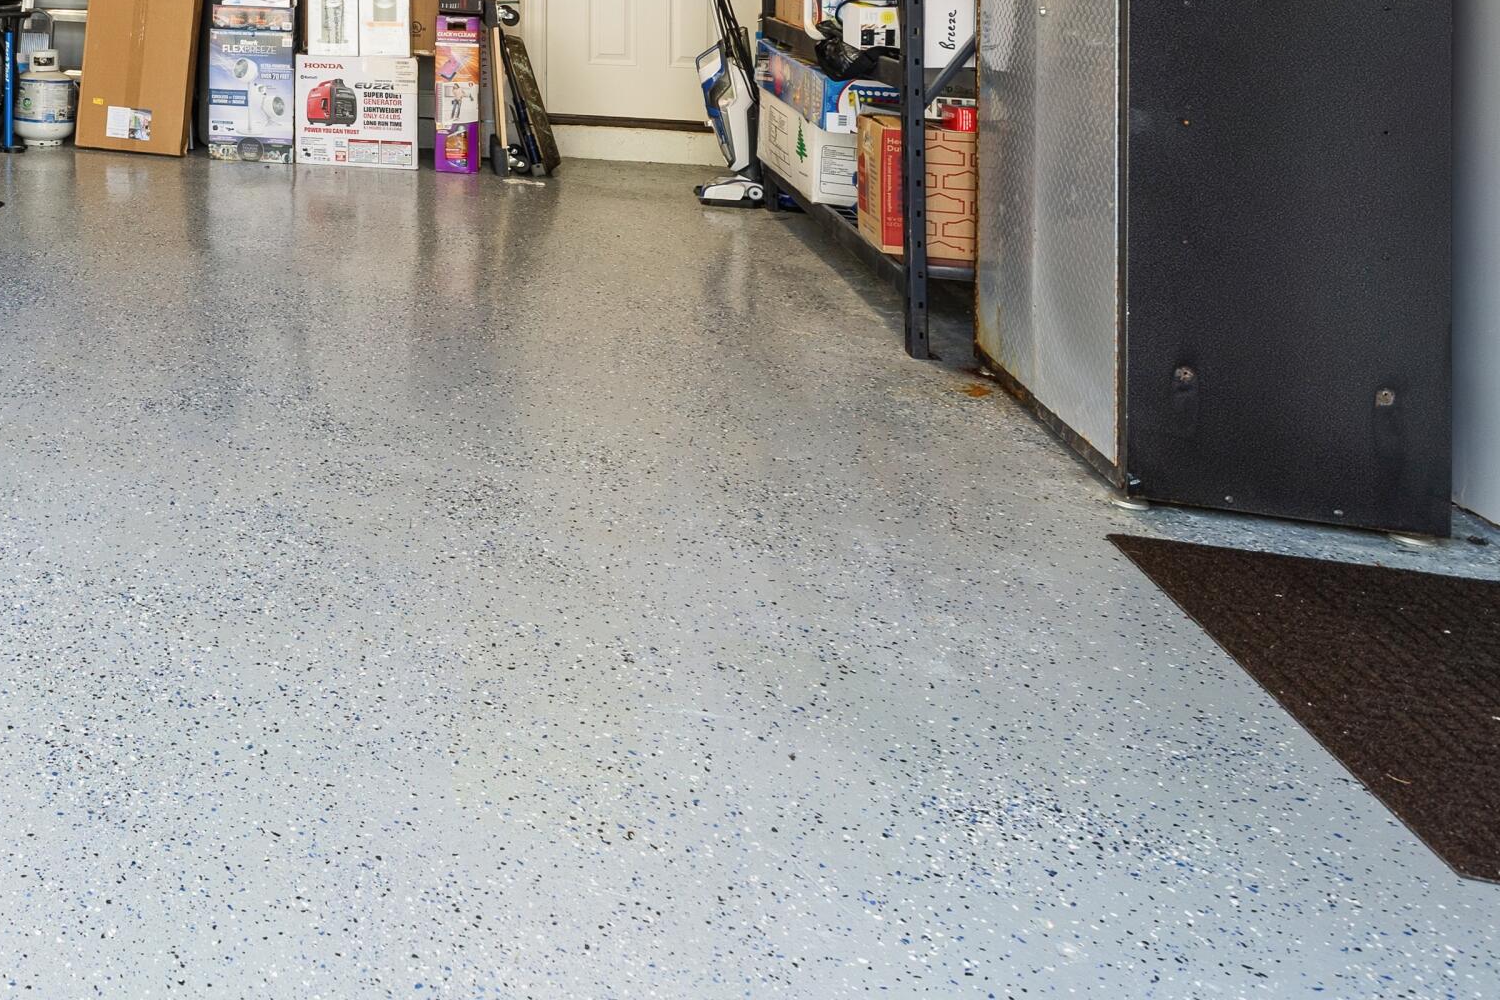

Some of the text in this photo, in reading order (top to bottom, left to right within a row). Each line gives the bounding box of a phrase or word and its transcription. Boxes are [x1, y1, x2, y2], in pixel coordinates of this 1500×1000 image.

[939, 9, 957, 50] Breeze
[222, 44, 276, 54] FLEXBREEZE
[304, 62, 344, 70] HONDA
[363, 91, 384, 99] SUPER
[363, 98, 402, 106] GENERATOR
[363, 106, 402, 114] LIGHTWEIGHT
